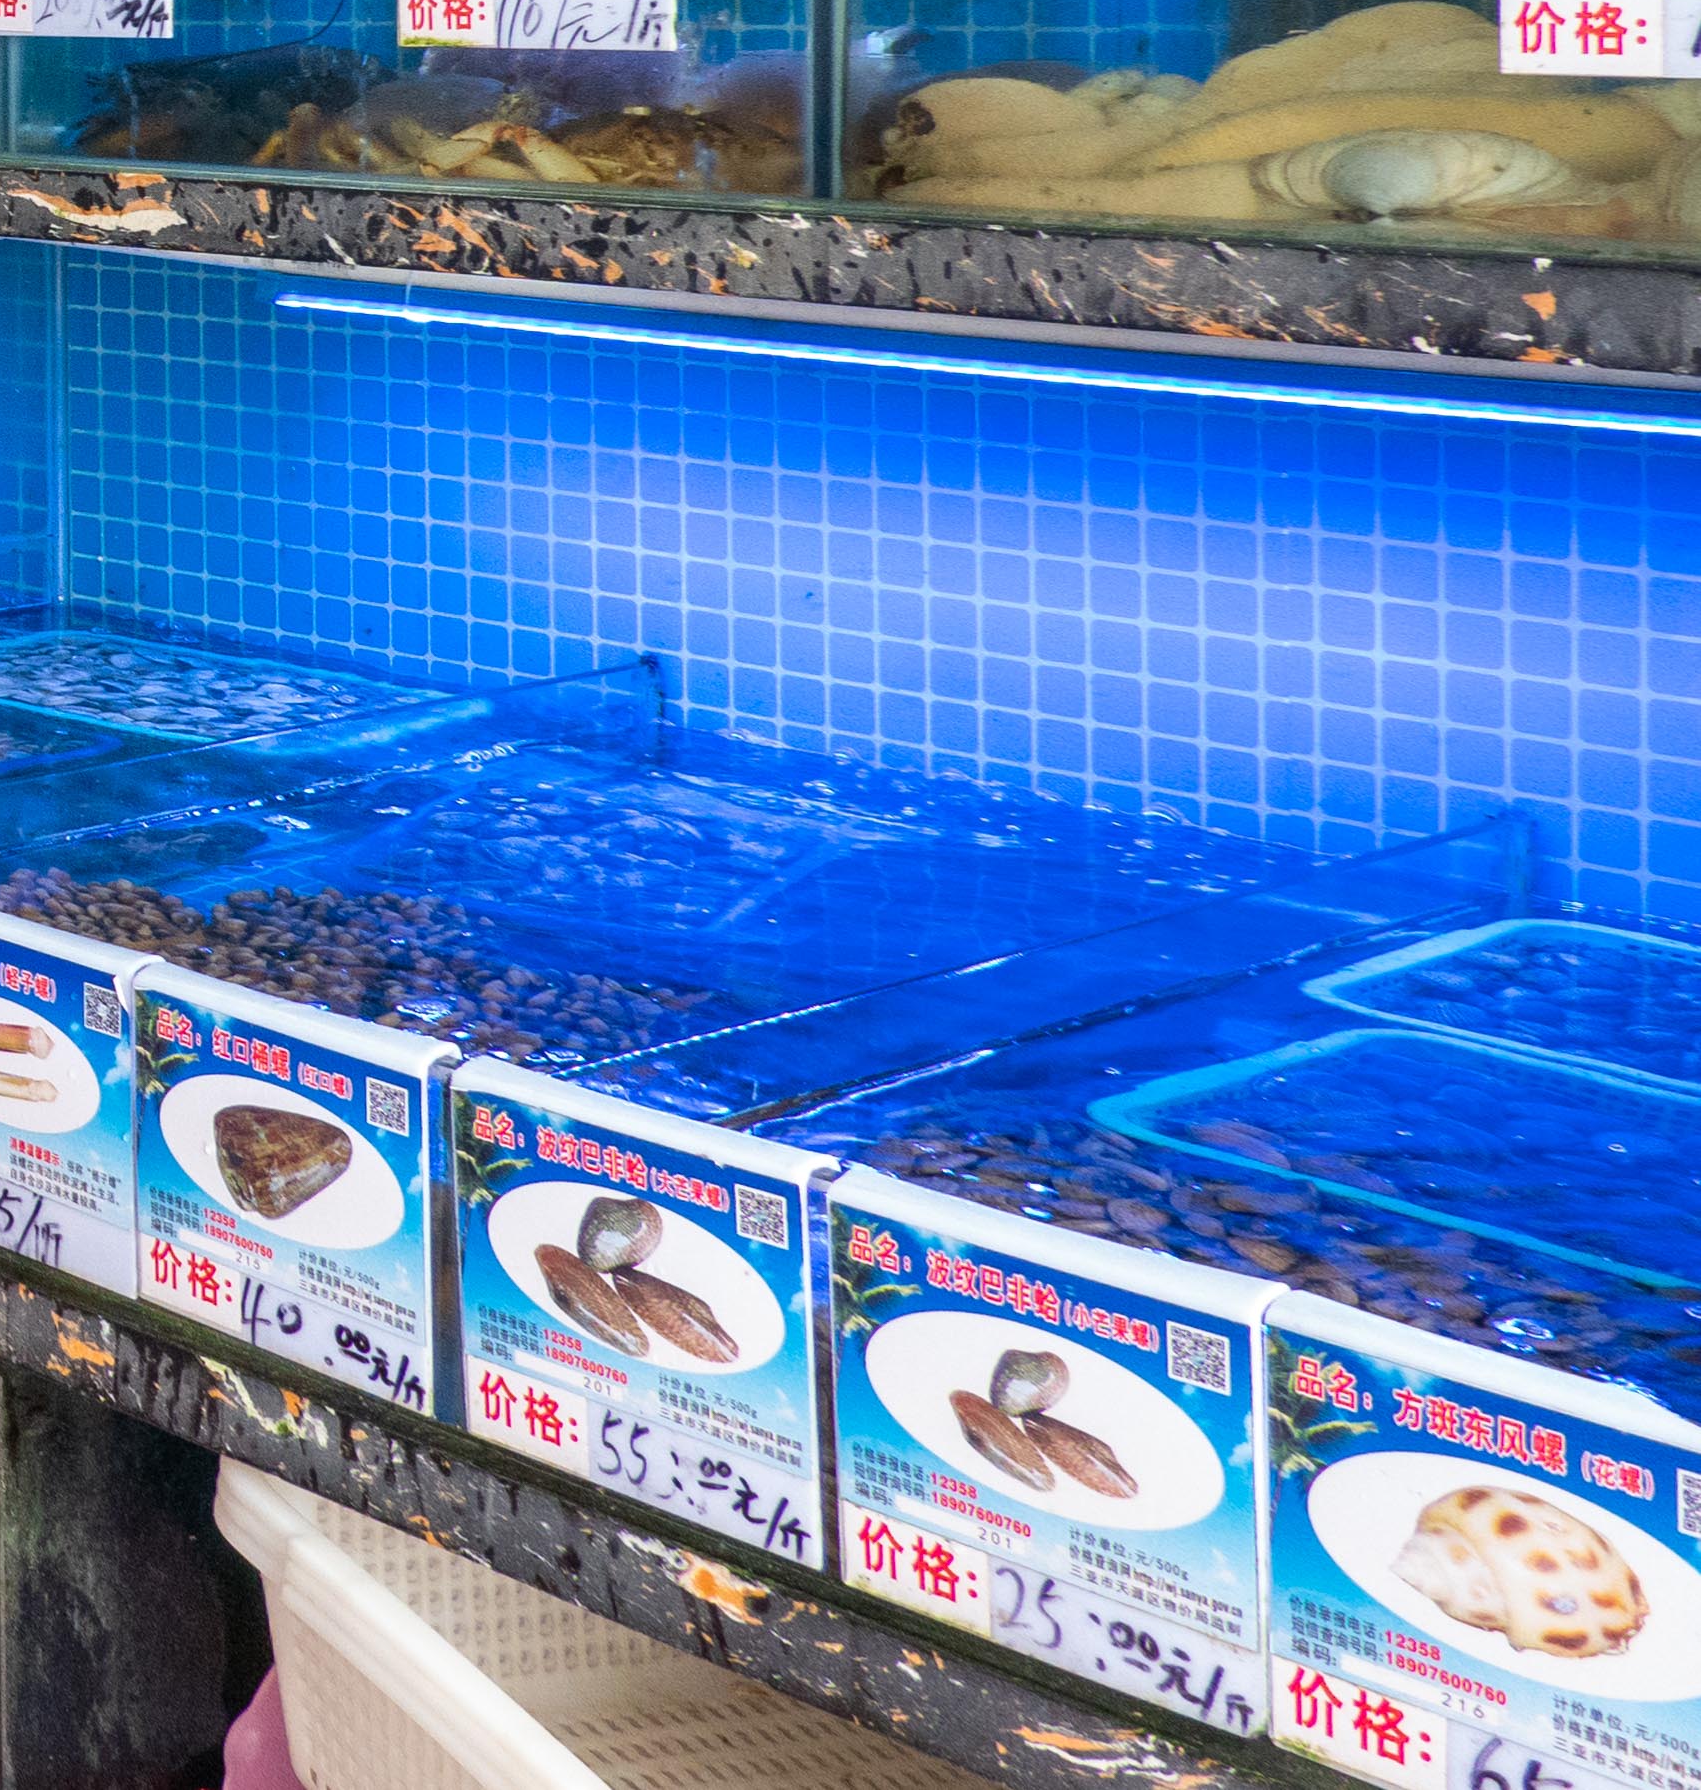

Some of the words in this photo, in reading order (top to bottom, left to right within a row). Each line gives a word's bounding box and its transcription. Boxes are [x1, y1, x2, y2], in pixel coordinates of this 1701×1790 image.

[1515, 1, 1647, 55] 价格:
[151, 1237, 233, 1307] 价格:
[848, 1226, 1061, 1326] 品名:波纹巴非蛤
[479, 1370, 579, 1448] 价格:
[1293, 1355, 1568, 1476] 品名:方斑东风螺
[1580, 1451, 1655, 1502] (花螺)
[857, 1515, 978, 1603] 价格:
[978, 1526, 1013, 1550] 201
[1287, 1665, 1433, 1765] 价格:
[1290, 1636, 1338, 1667] 编码:
[1439, 1692, 1486, 1720] 216
